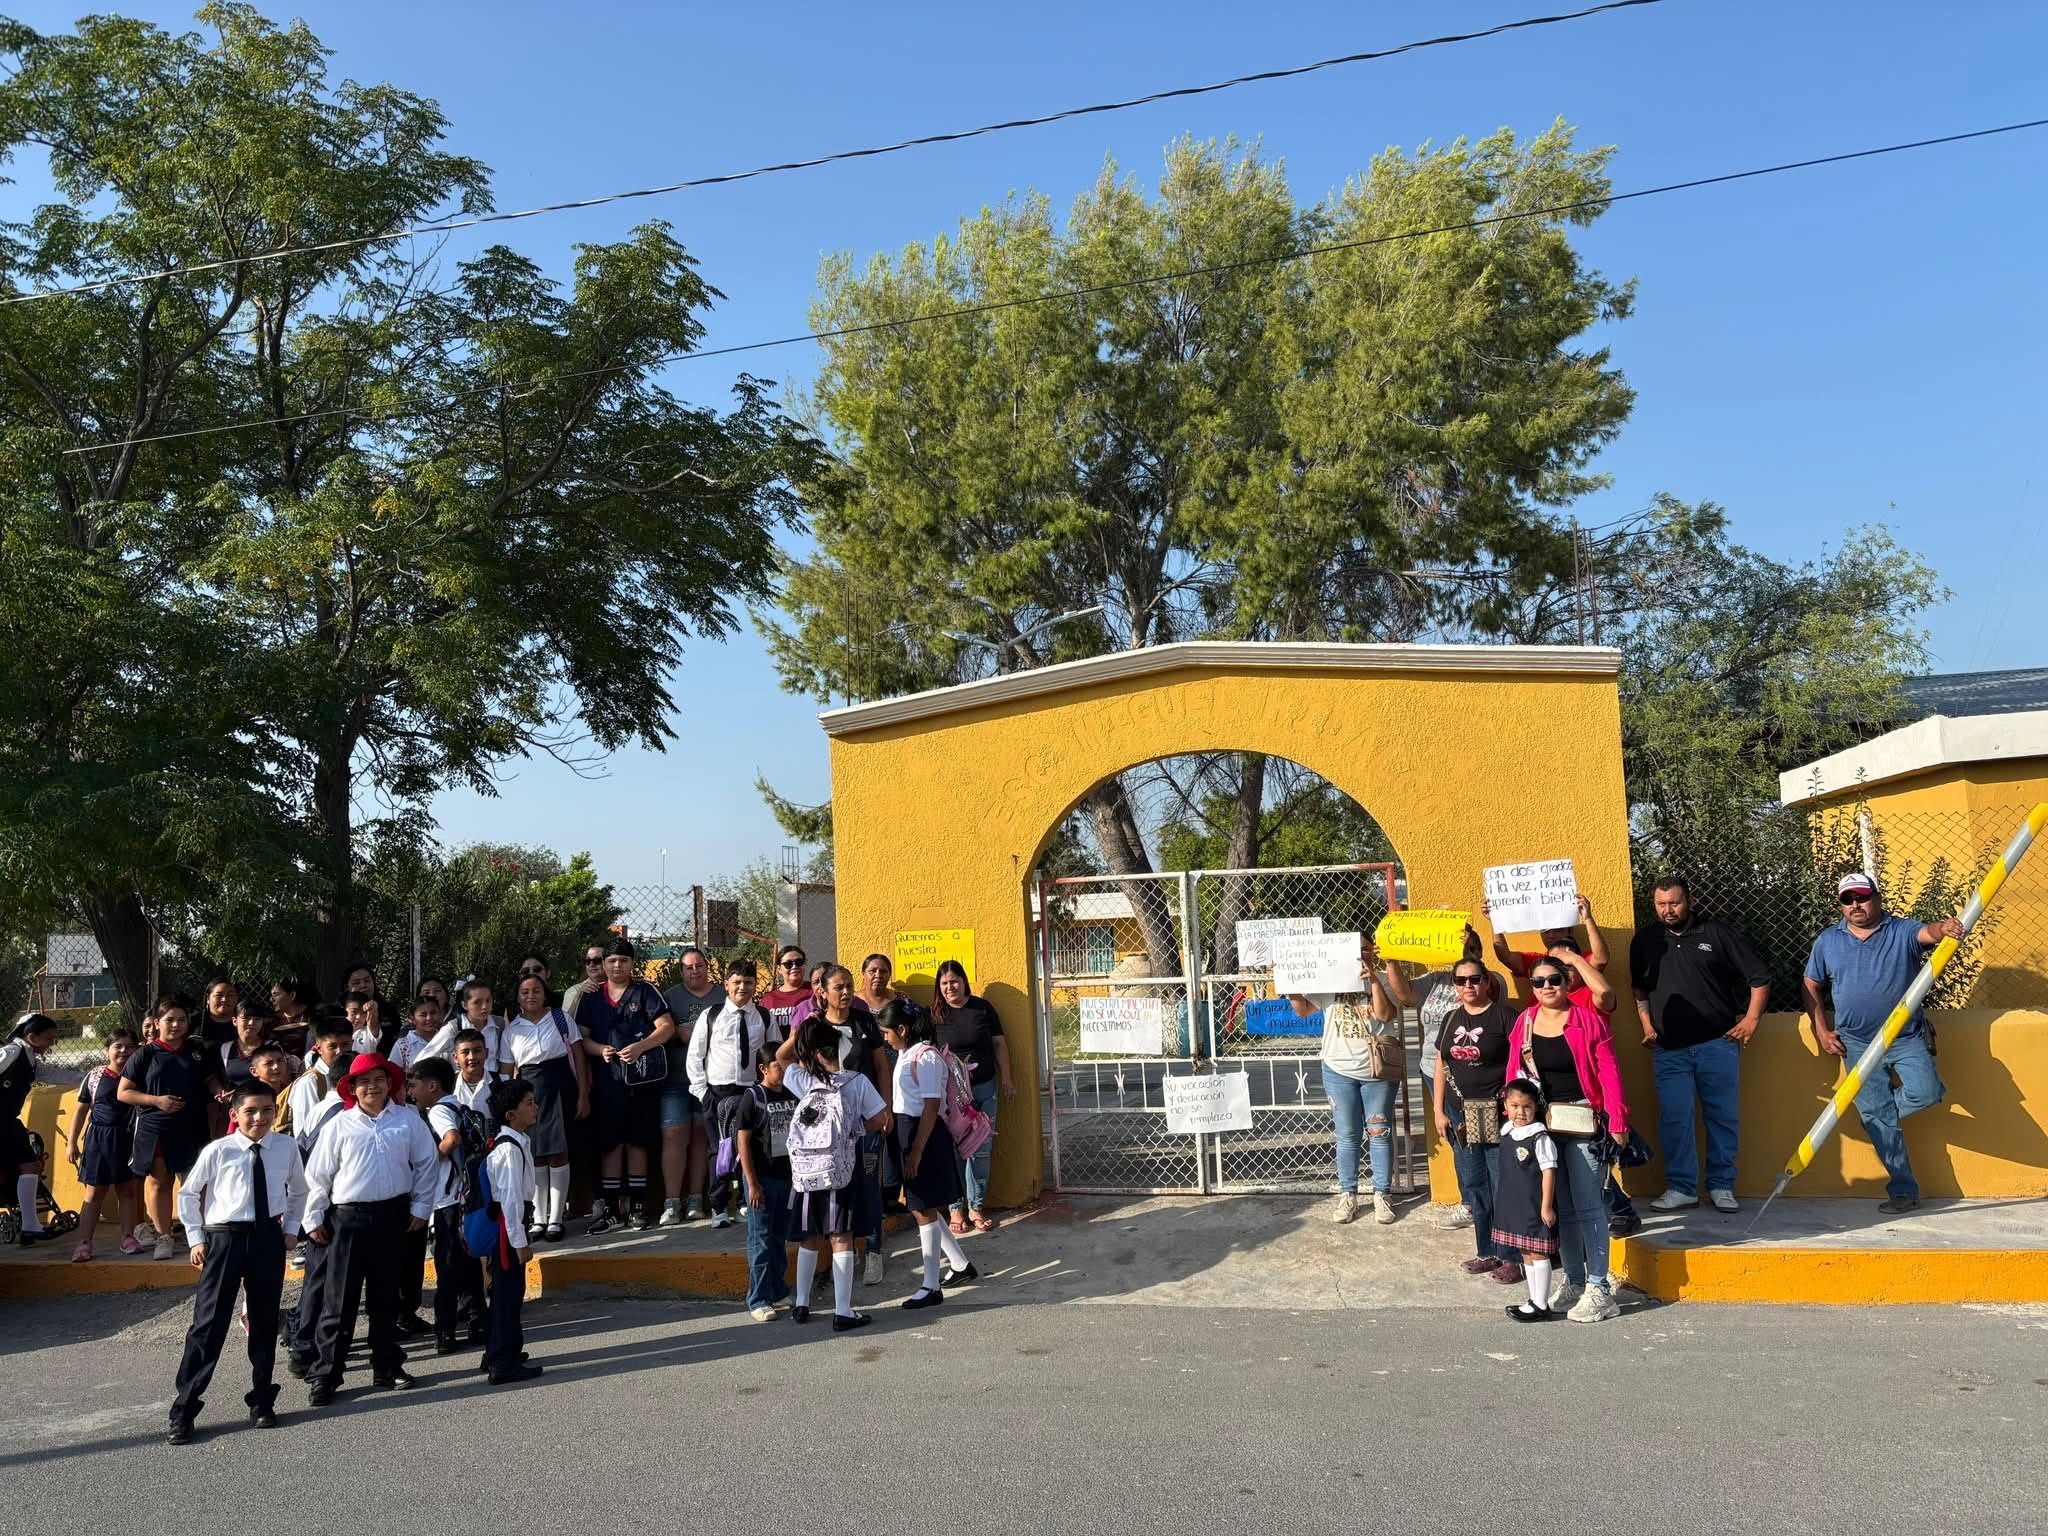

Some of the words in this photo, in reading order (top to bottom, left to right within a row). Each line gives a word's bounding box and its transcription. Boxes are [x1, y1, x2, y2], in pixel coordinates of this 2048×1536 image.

[1484, 868, 1505, 881] Con
[1510, 866, 1535, 877] dos
[1540, 861, 1573, 880] grados
[1497, 880, 1509, 893] la
[1511, 880, 1537, 893] vez,
[1540, 874, 1573, 889] nadie
[1383, 919, 1396, 930] de
[895, 932, 943, 946] Queremos
[951, 932, 960, 940] a
[1244, 931, 1252, 940] LA
[1253, 929, 1287, 940] MAESTRA
[1387, 932, 1432, 948] Calidad
[898, 944, 937, 956] nuestra
[1278, 959, 1317, 971] maestra
[1081, 998, 1120, 1010] NUESTRA
[1122, 998, 1159, 1011] MAESTRA
[1081, 1009, 1095, 1020] NO
[1095, 1008, 1105, 1020] SE
[1082, 1020, 1133, 1033] NECESITAMOS
[1270, 1017, 1322, 1031] maestra
[1164, 1080, 1177, 1093] Su
[1170, 1106, 1184, 1115] no
[1191, 1104, 1203, 1113] se
